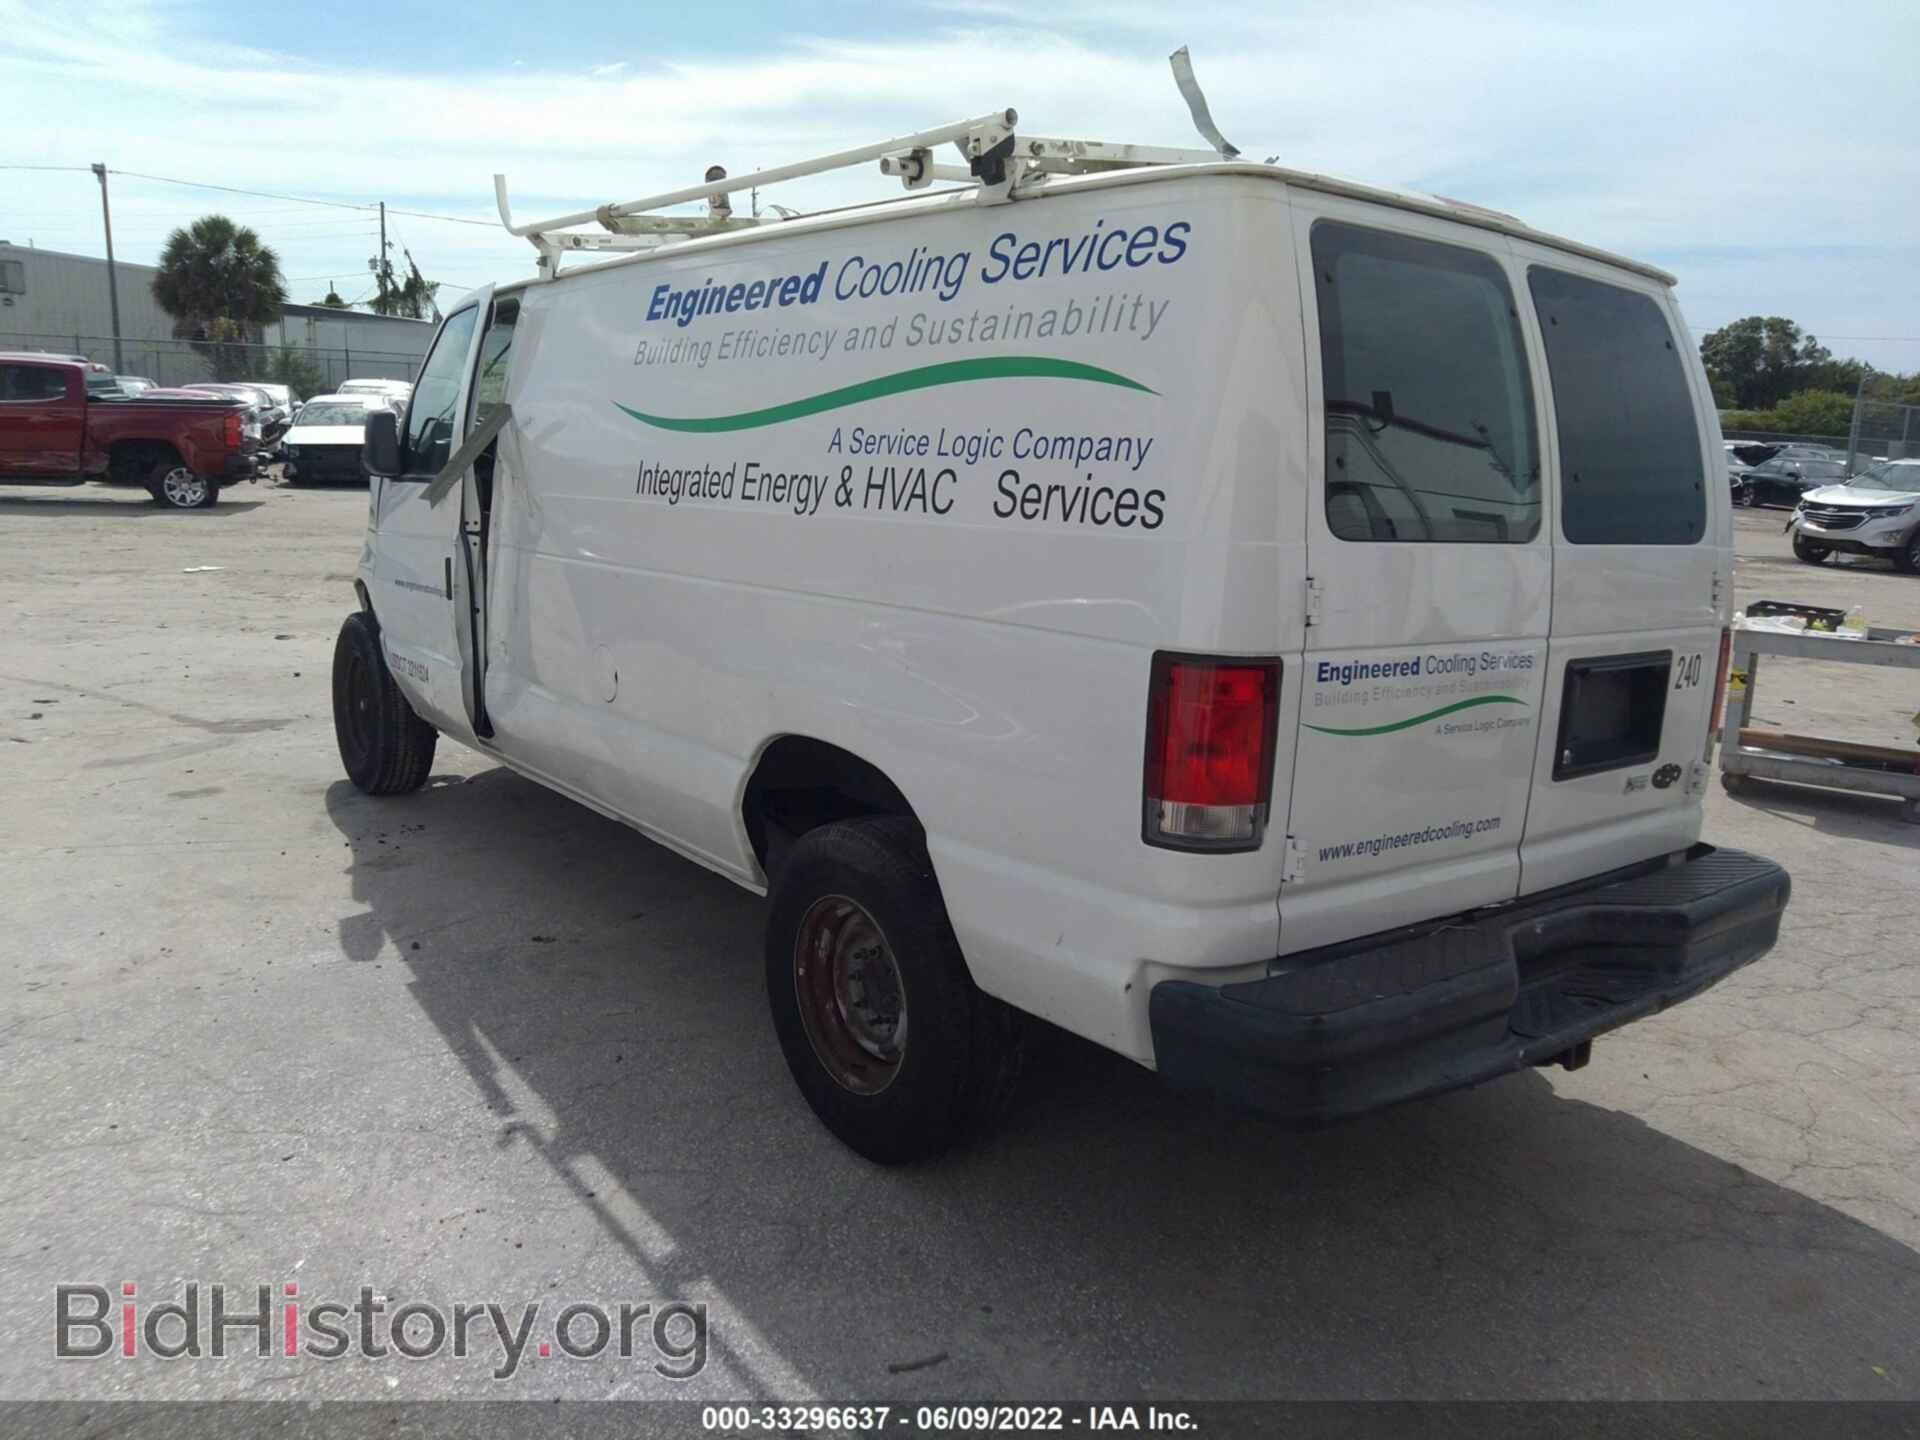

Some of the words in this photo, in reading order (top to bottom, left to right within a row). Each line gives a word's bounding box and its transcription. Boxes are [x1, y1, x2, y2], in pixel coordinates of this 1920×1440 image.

[646, 261, 827, 328] Engineered
[834, 247, 970, 301] Cooling
[981, 220, 1191, 284] Services
[633, 334, 711, 368] Building
[717, 326, 837, 364] Efficiency
[843, 316, 897, 350] and
[905, 294, 1169, 347] Sustainability
[828, 428, 842, 454] A
[849, 427, 929, 457] Service
[936, 428, 1004, 465] Logic
[1012, 428, 1153, 470] Company
[637, 459, 736, 505] Integrated
[741, 462, 828, 516] Energy
[834, 465, 854, 507] &
[863, 466, 958, 514] HVAC
[993, 469, 1166, 530] Services
[1317, 656, 1420, 685] Engineered
[1425, 655, 1476, 676] Cooling
[1480, 651, 1533, 671] Services
[1674, 654, 1701, 690] 240
[1314, 690, 1369, 707] Building
[1319, 816, 1501, 862] www.engineeredcooling.com
